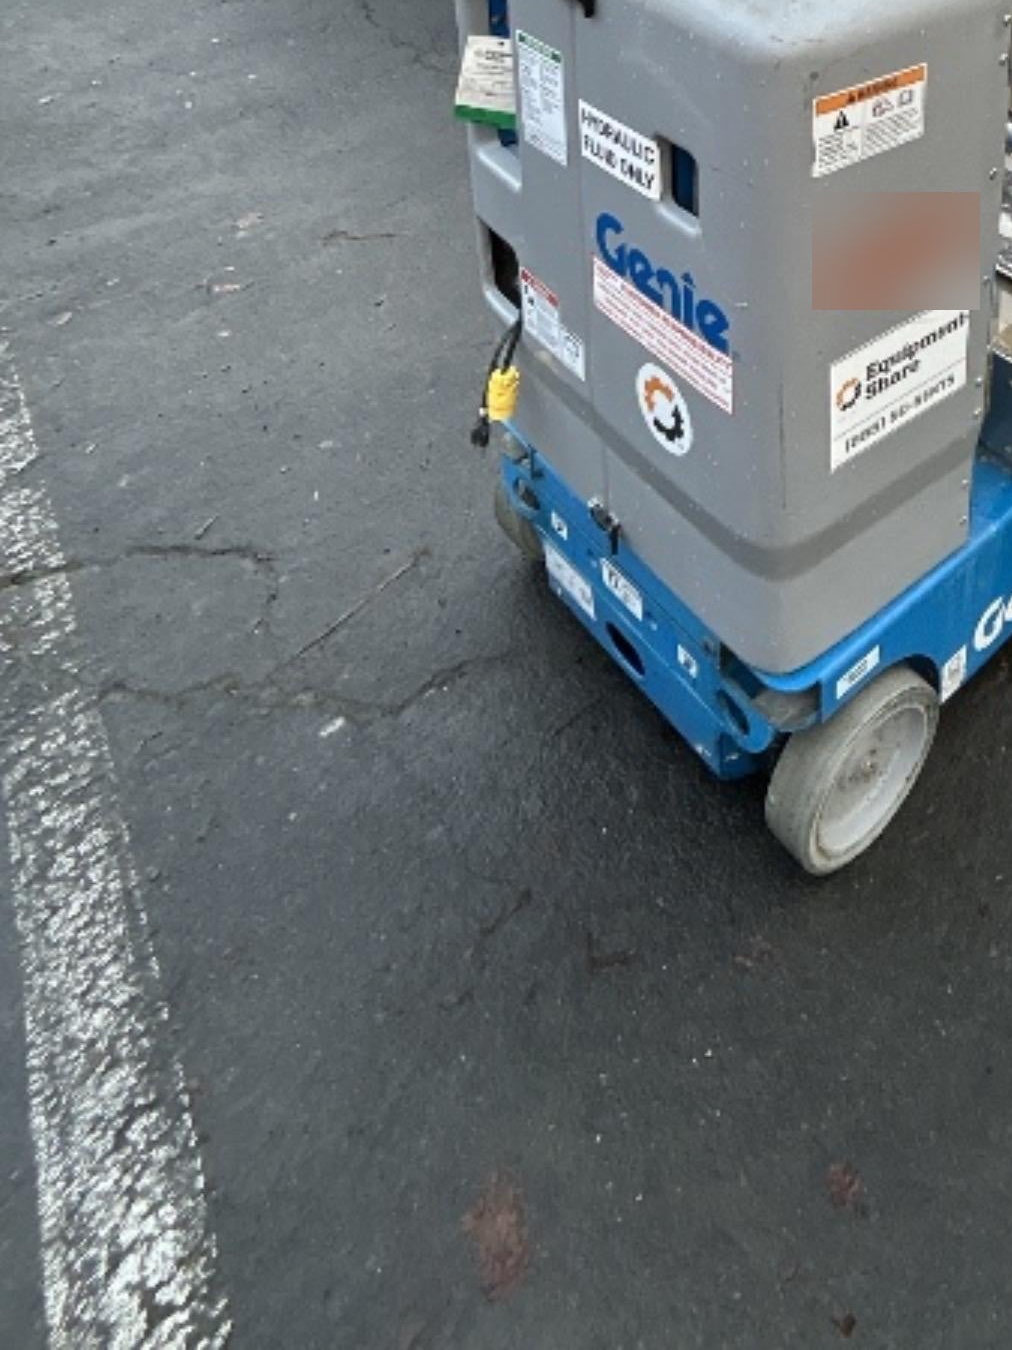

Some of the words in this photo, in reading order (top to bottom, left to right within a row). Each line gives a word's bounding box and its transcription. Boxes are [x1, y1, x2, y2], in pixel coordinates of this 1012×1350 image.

[596, 212, 730, 356] Genie
[866, 311, 968, 382] Equipment
[866, 358, 921, 400] Share
